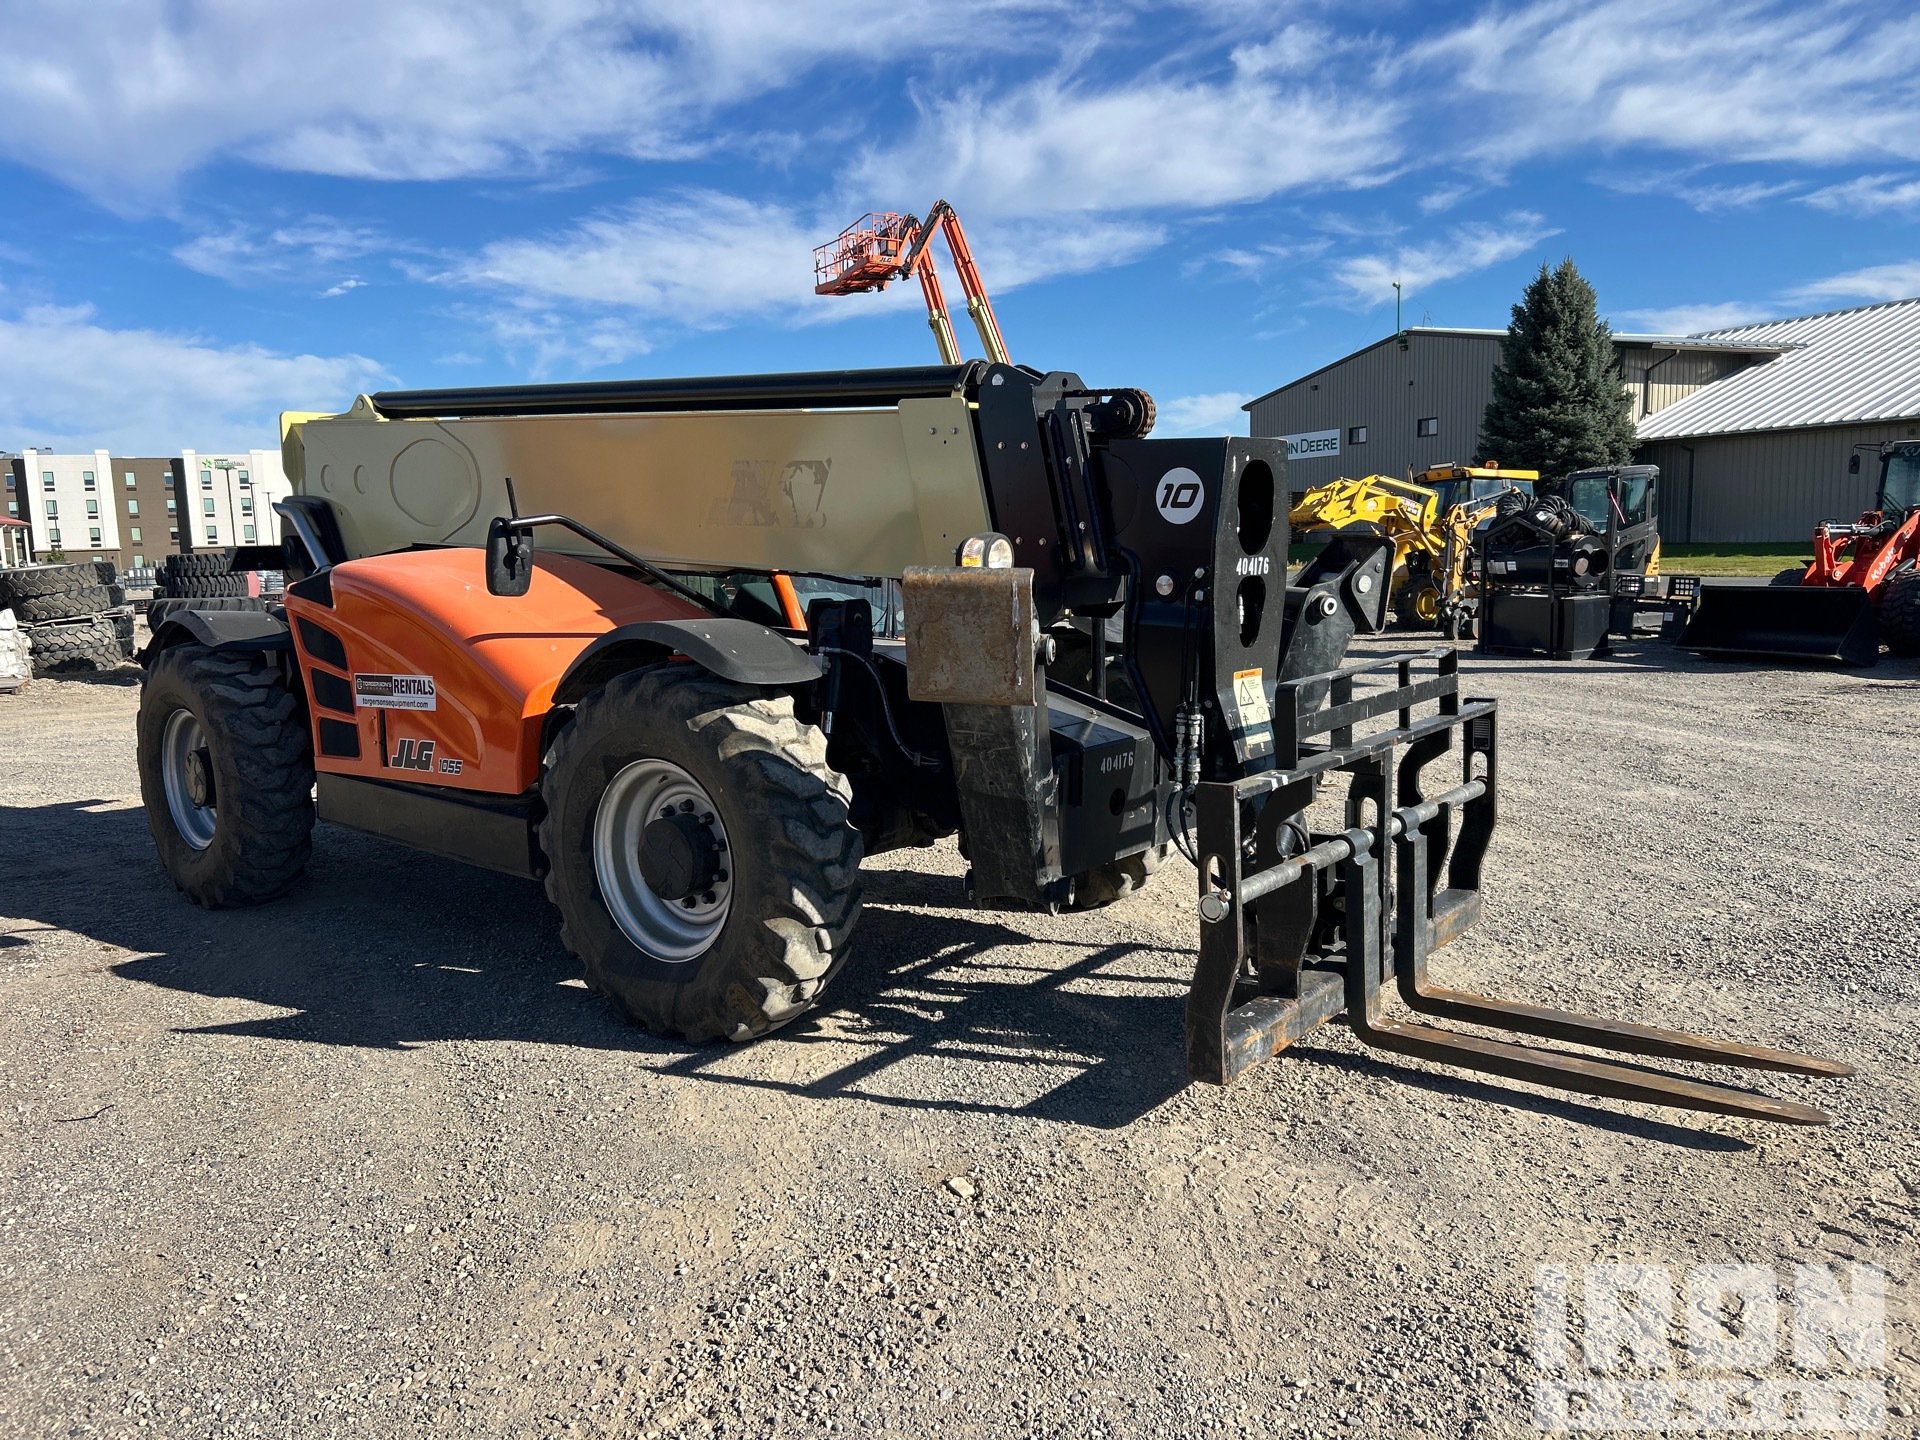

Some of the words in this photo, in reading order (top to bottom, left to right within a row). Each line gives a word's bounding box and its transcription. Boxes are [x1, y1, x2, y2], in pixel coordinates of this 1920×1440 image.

[1300, 438, 1338, 453] DEERE
[1160, 483, 1200, 508] 10
[1236, 557, 1269, 576] 404176
[393, 678, 435, 696] RENTALS
[362, 697, 429, 709] torgersonsequipment.com
[389, 737, 436, 772] JLG
[438, 757, 464, 775] 1055
[1100, 751, 1134, 774] 404176
